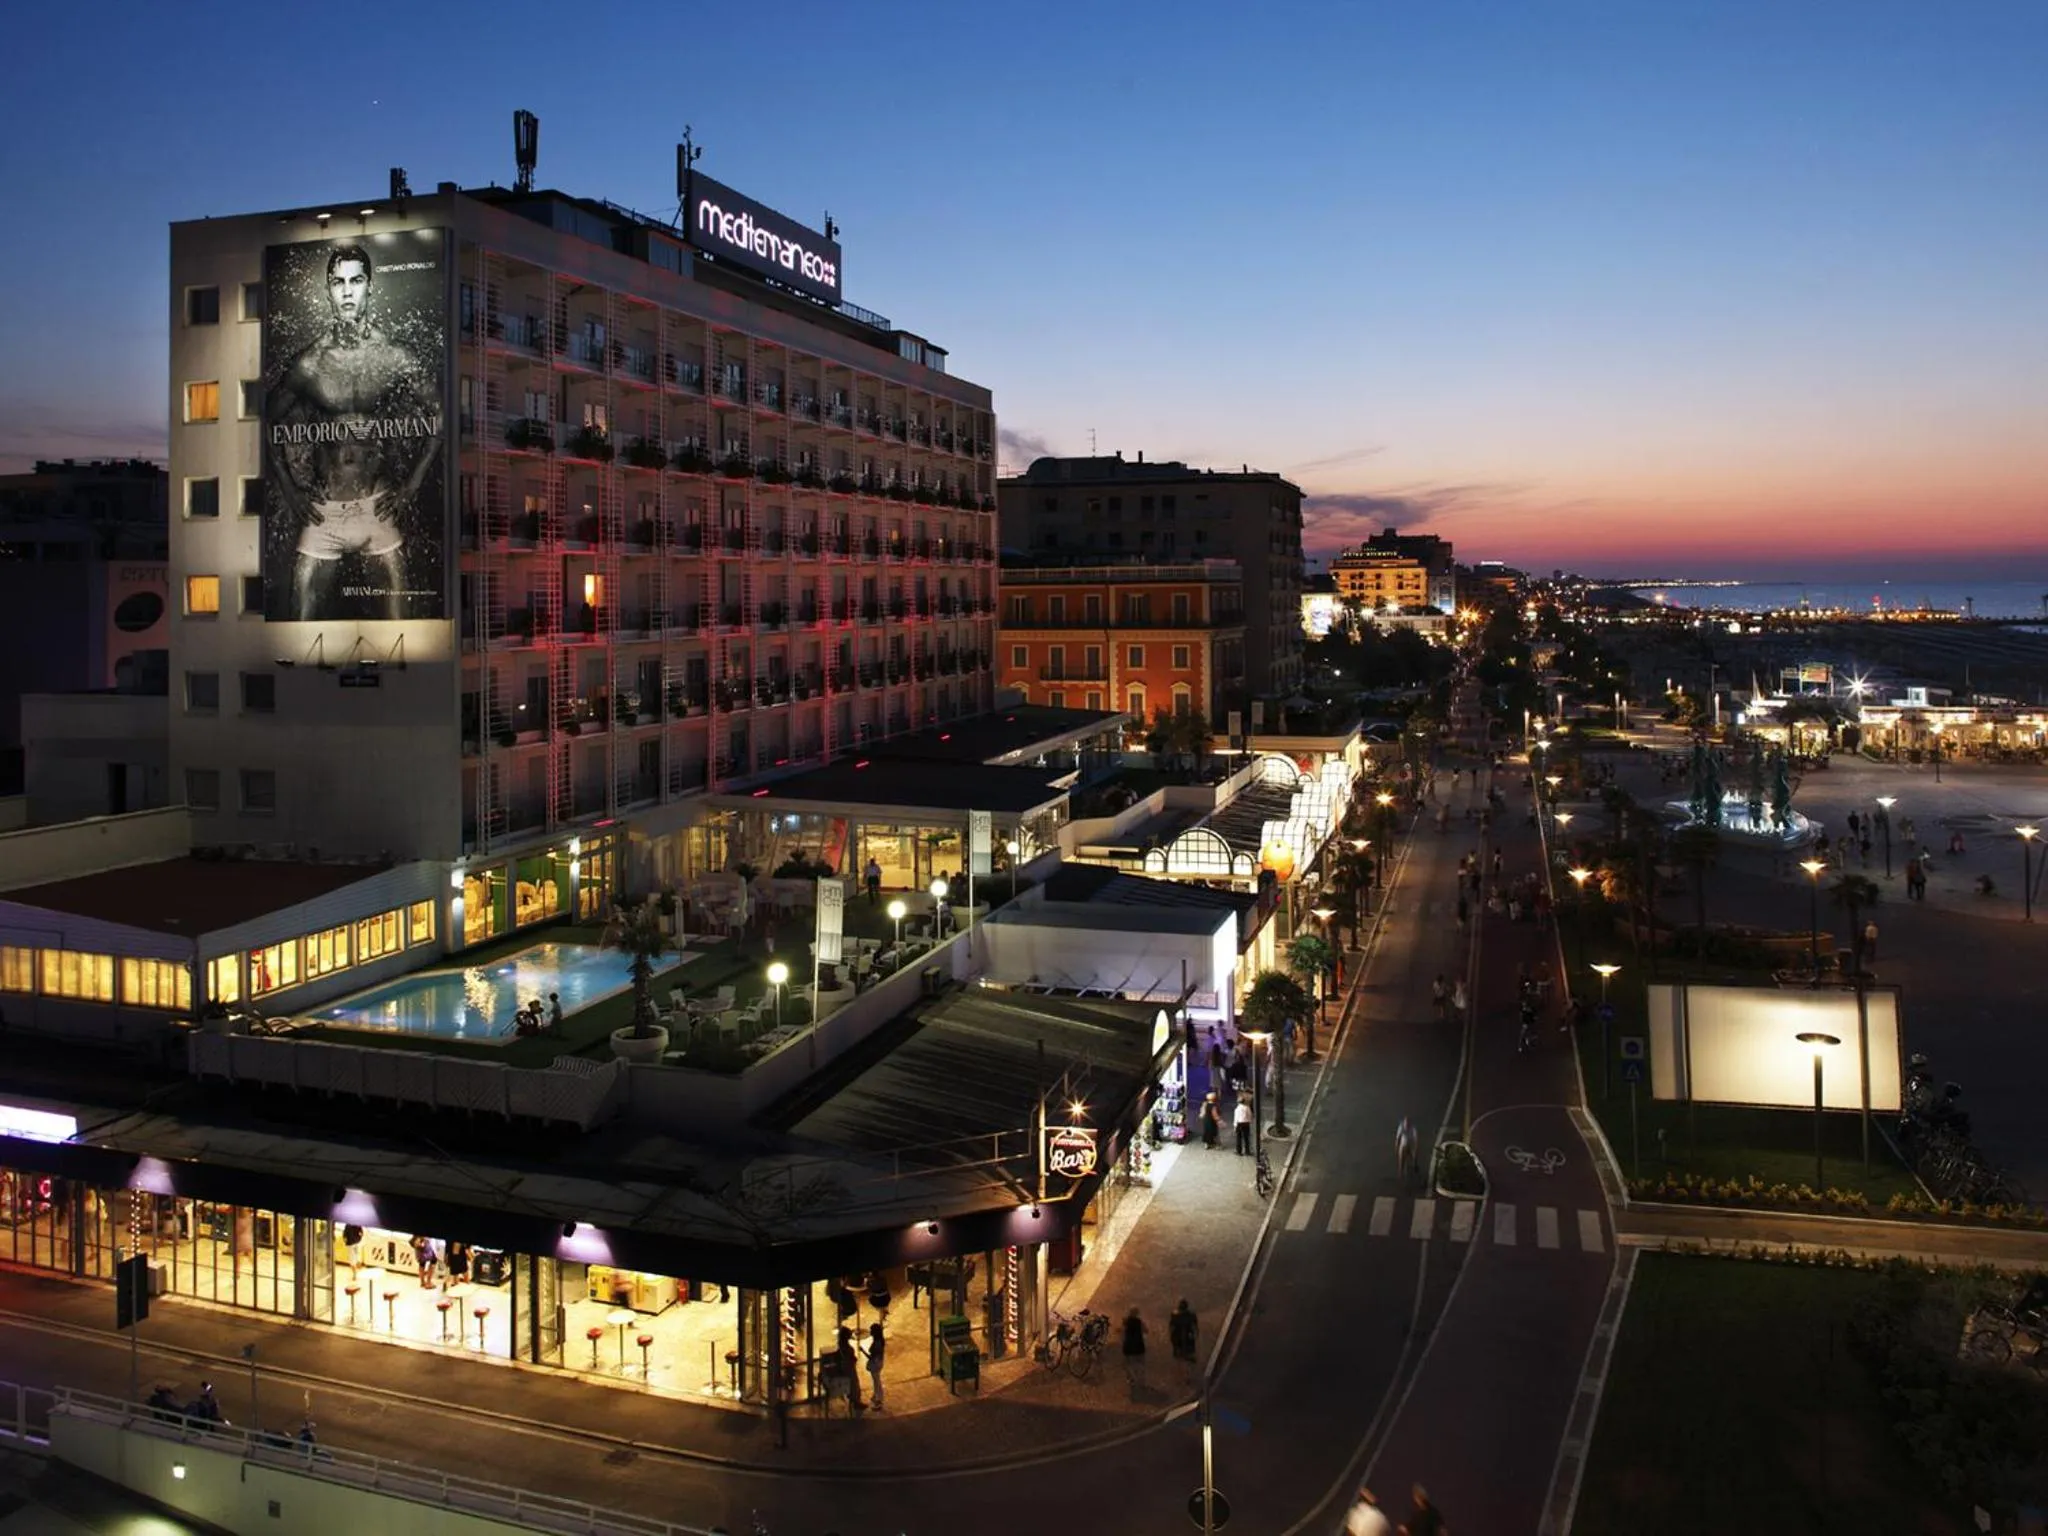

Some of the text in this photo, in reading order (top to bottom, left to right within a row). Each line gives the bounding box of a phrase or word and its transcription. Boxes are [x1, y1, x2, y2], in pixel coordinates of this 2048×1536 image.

[273, 415, 438, 445] EMPORIO ARMANI
[1050, 1149, 1085, 1171] Bar
